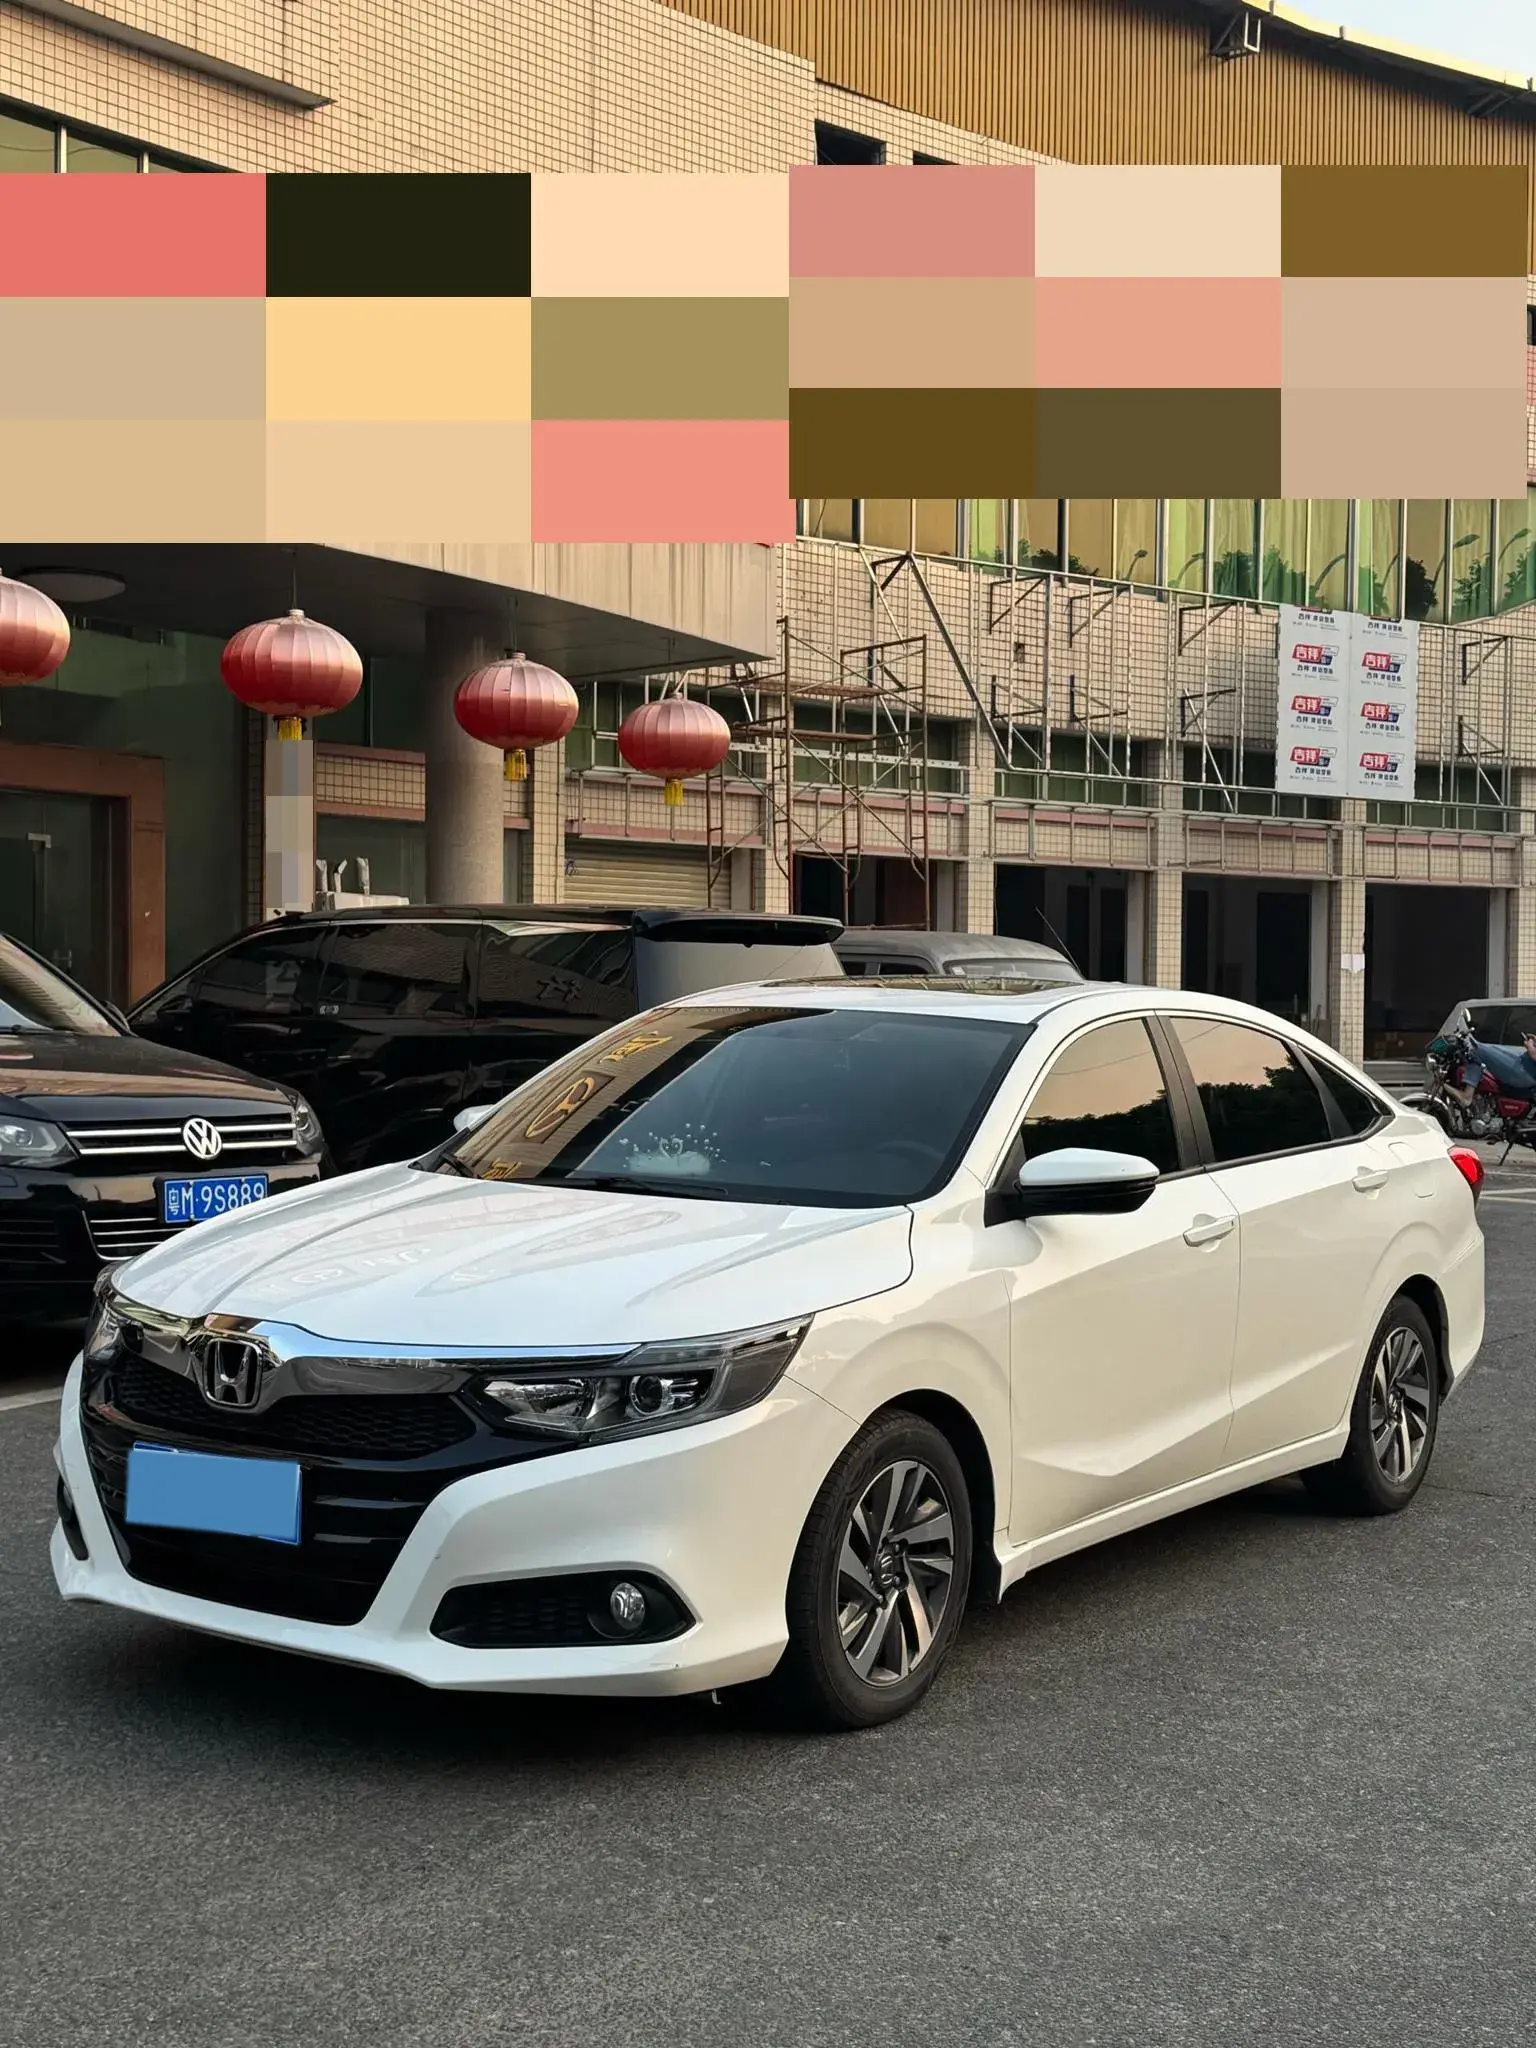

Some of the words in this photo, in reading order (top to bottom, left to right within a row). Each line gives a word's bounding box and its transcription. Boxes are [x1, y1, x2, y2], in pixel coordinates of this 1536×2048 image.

[1296, 646, 1319, 660] 吉祥
[1365, 654, 1387, 668] 吉祥
[1295, 697, 1318, 712] 吉祥
[1364, 704, 1387, 718] 吉祥
[1294, 748, 1317, 763] 吉祥
[1362, 754, 1385, 769] 吉祥
